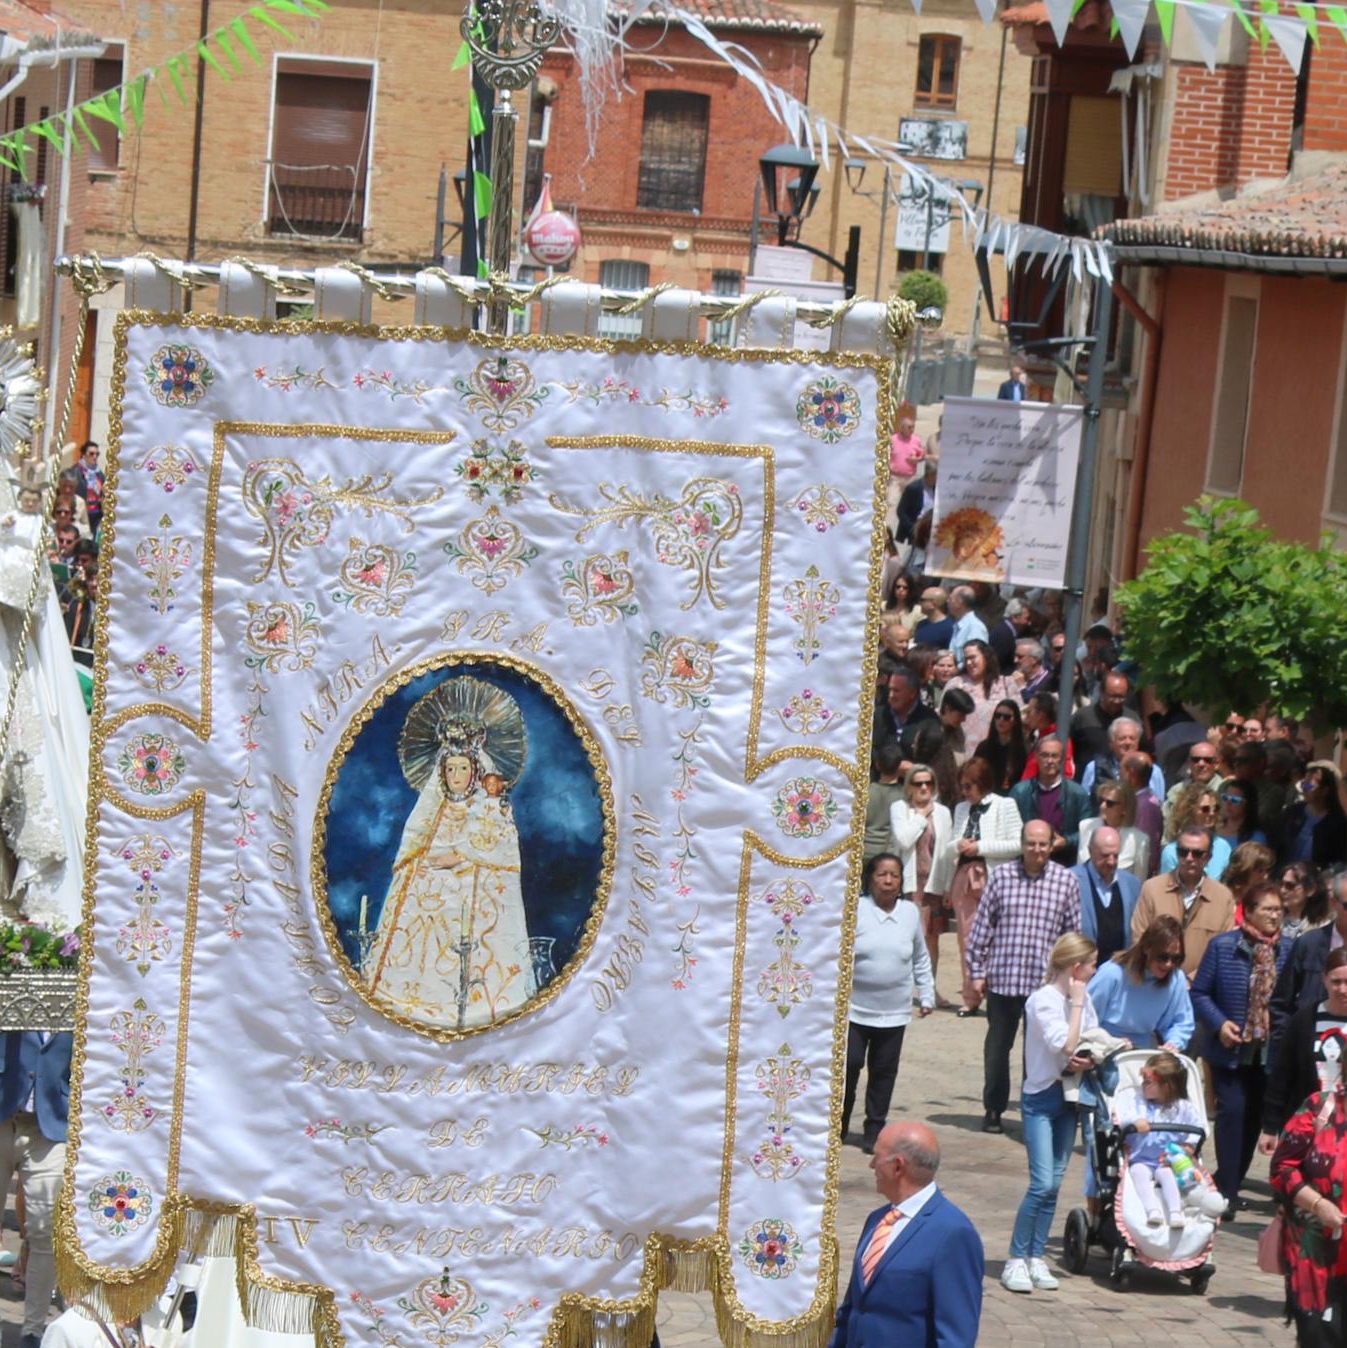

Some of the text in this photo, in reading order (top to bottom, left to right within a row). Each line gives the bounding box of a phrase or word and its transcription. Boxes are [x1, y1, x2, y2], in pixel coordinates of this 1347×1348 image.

[579, 667, 643, 748] DEL
[590, 793, 661, 1012] MILAGRO
[297, 1055, 643, 1097] VILLAMURIEL
[426, 1115, 490, 1148] DE
[340, 1166, 557, 1206] CERRATO
[263, 1215, 640, 1262] IV CENTENARIO
